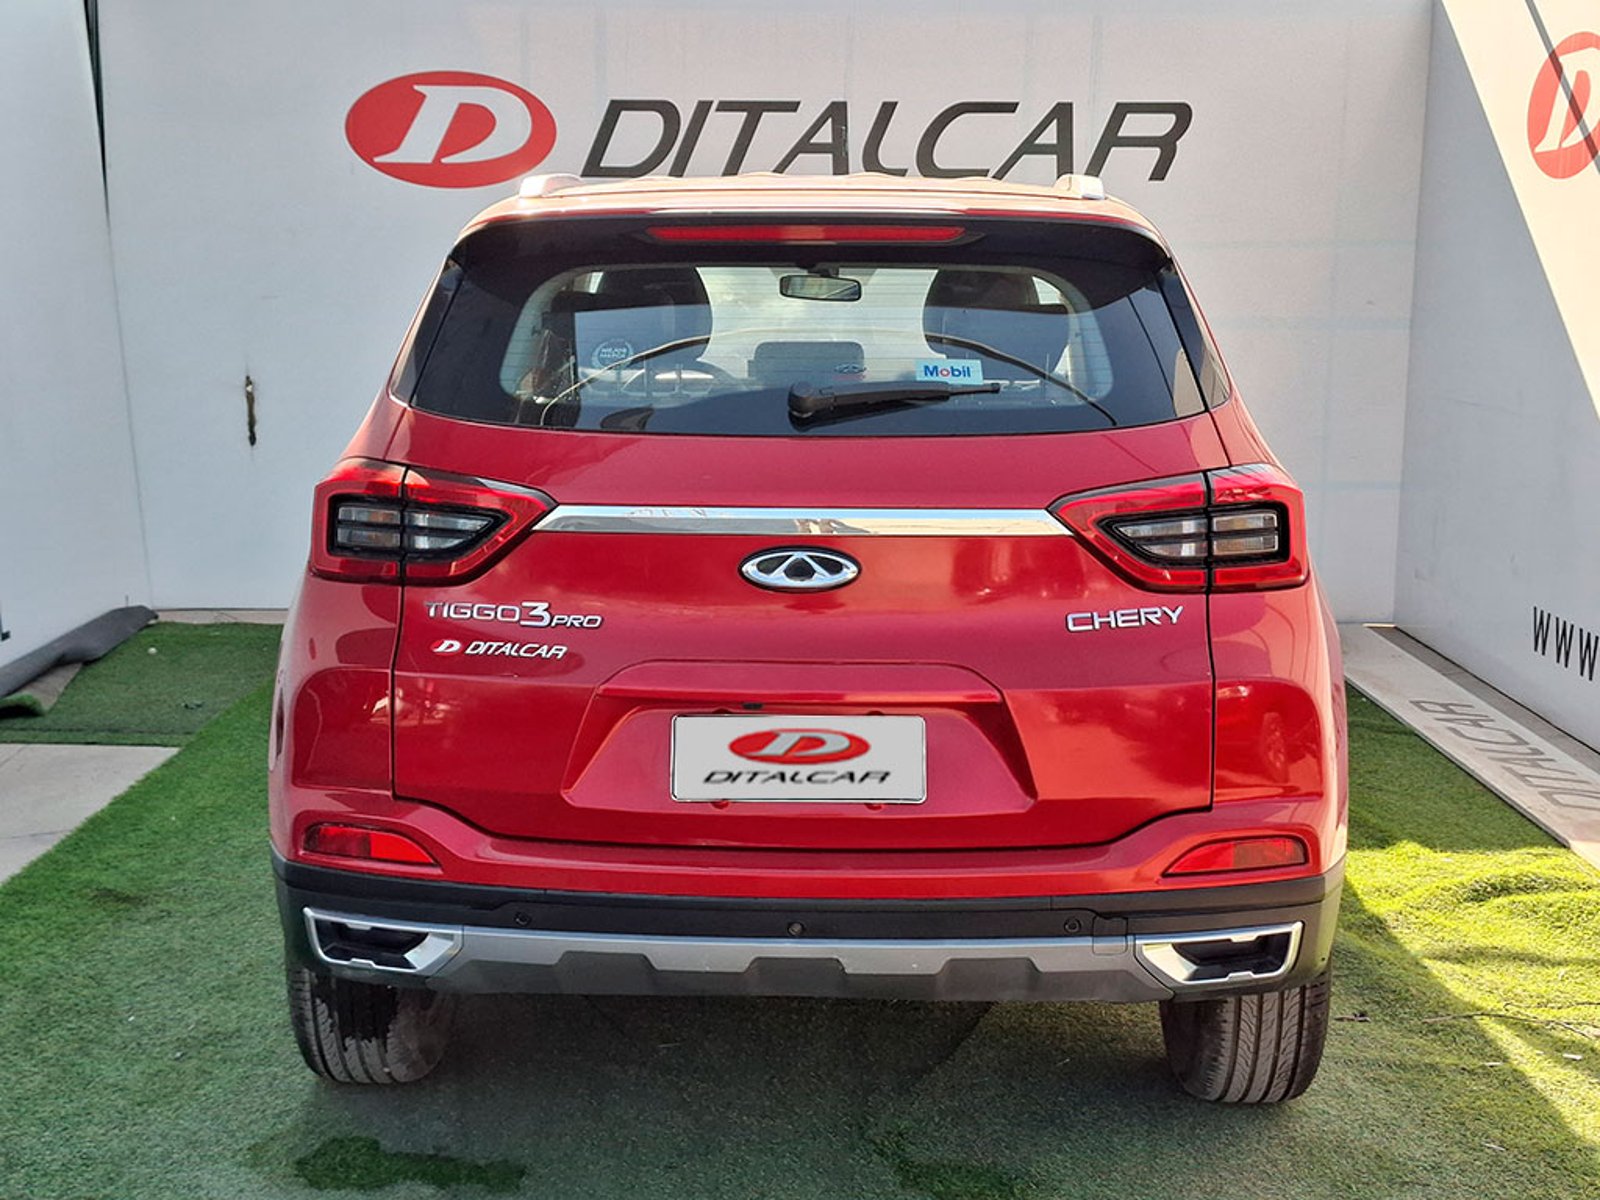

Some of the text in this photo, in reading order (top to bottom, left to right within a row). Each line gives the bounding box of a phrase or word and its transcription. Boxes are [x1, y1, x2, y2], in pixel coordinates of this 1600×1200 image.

[580, 99, 1193, 181] DITALCAR
[924, 365, 971, 378] Mobil
[1066, 606, 1184, 632] CHERY
[465, 641, 568, 659] DITALCAR
[703, 770, 891, 785] DITALCAR
